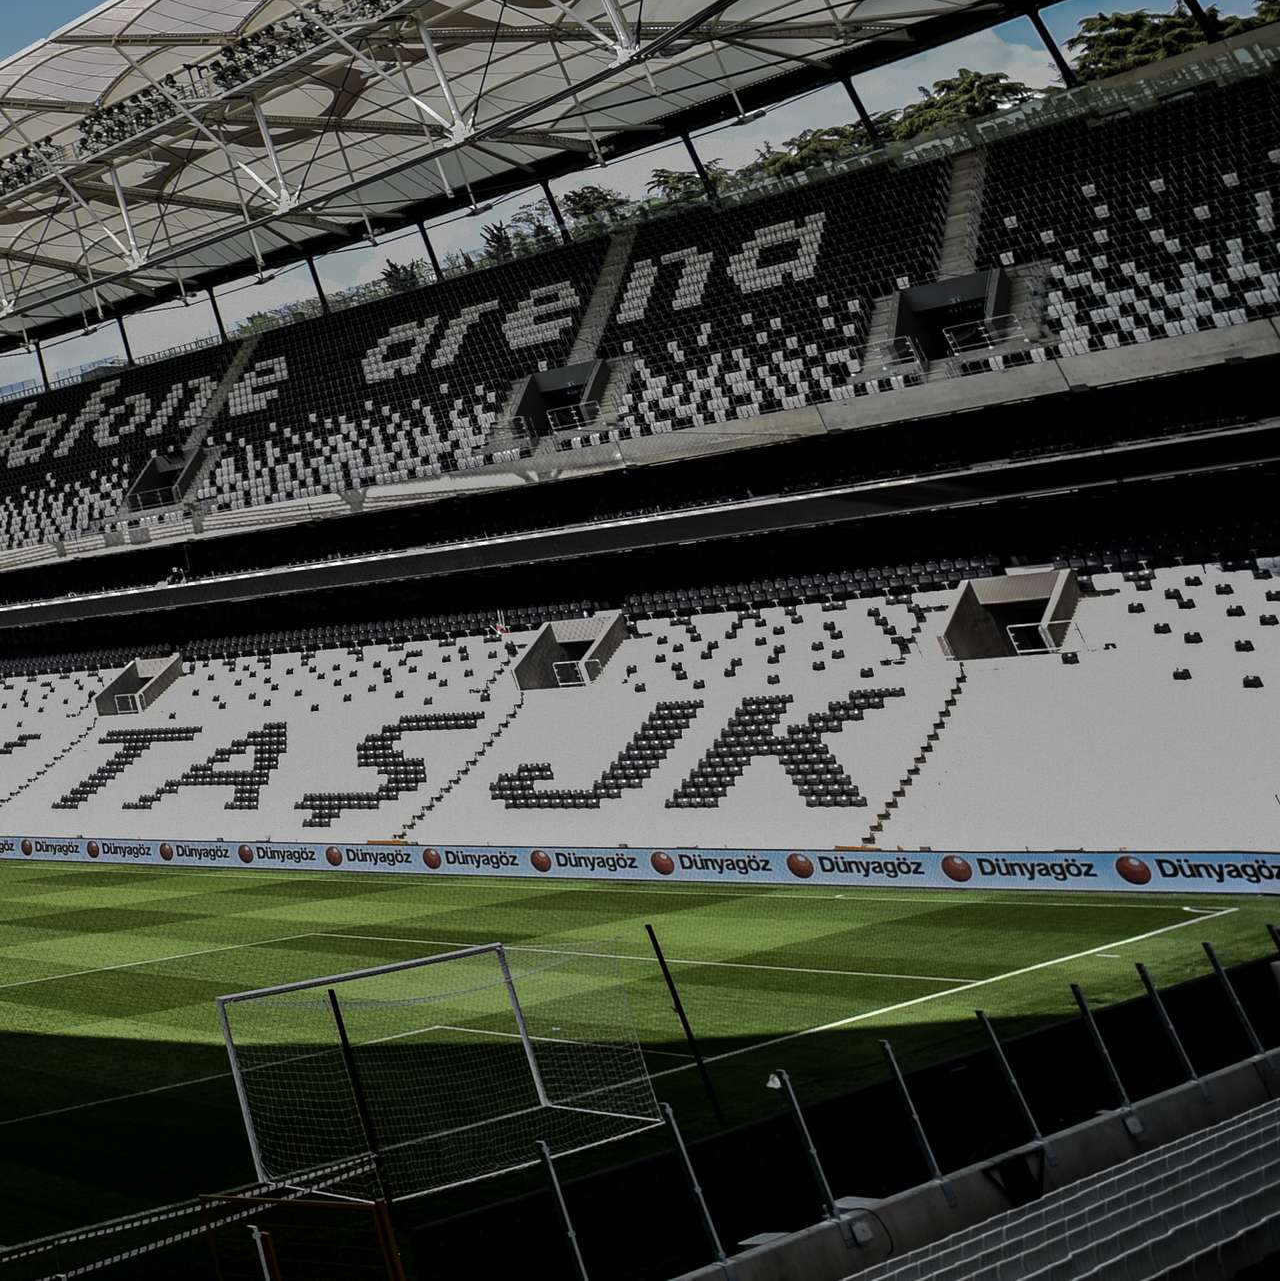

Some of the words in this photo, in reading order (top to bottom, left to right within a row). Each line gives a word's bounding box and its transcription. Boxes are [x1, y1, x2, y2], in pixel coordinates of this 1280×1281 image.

[361, 212, 826, 384] arena
[490, 687, 906, 809] JK
[35, 841, 80, 854] Dünyagöz
[102, 843, 151, 857] Dünyagöz
[176, 845, 229, 859] Dünyagöz
[256, 846, 316, 862] Dünyagöz
[345, 848, 412, 866] Dünyagöz
[445, 851, 518, 869] Dünyagöz
[555, 852, 638, 871] Dünyagöz
[678, 853, 772, 876] Dünyagöz
[818, 854, 925, 878] Dünyagöz
[977, 857, 1097, 880] Dünyagöz
